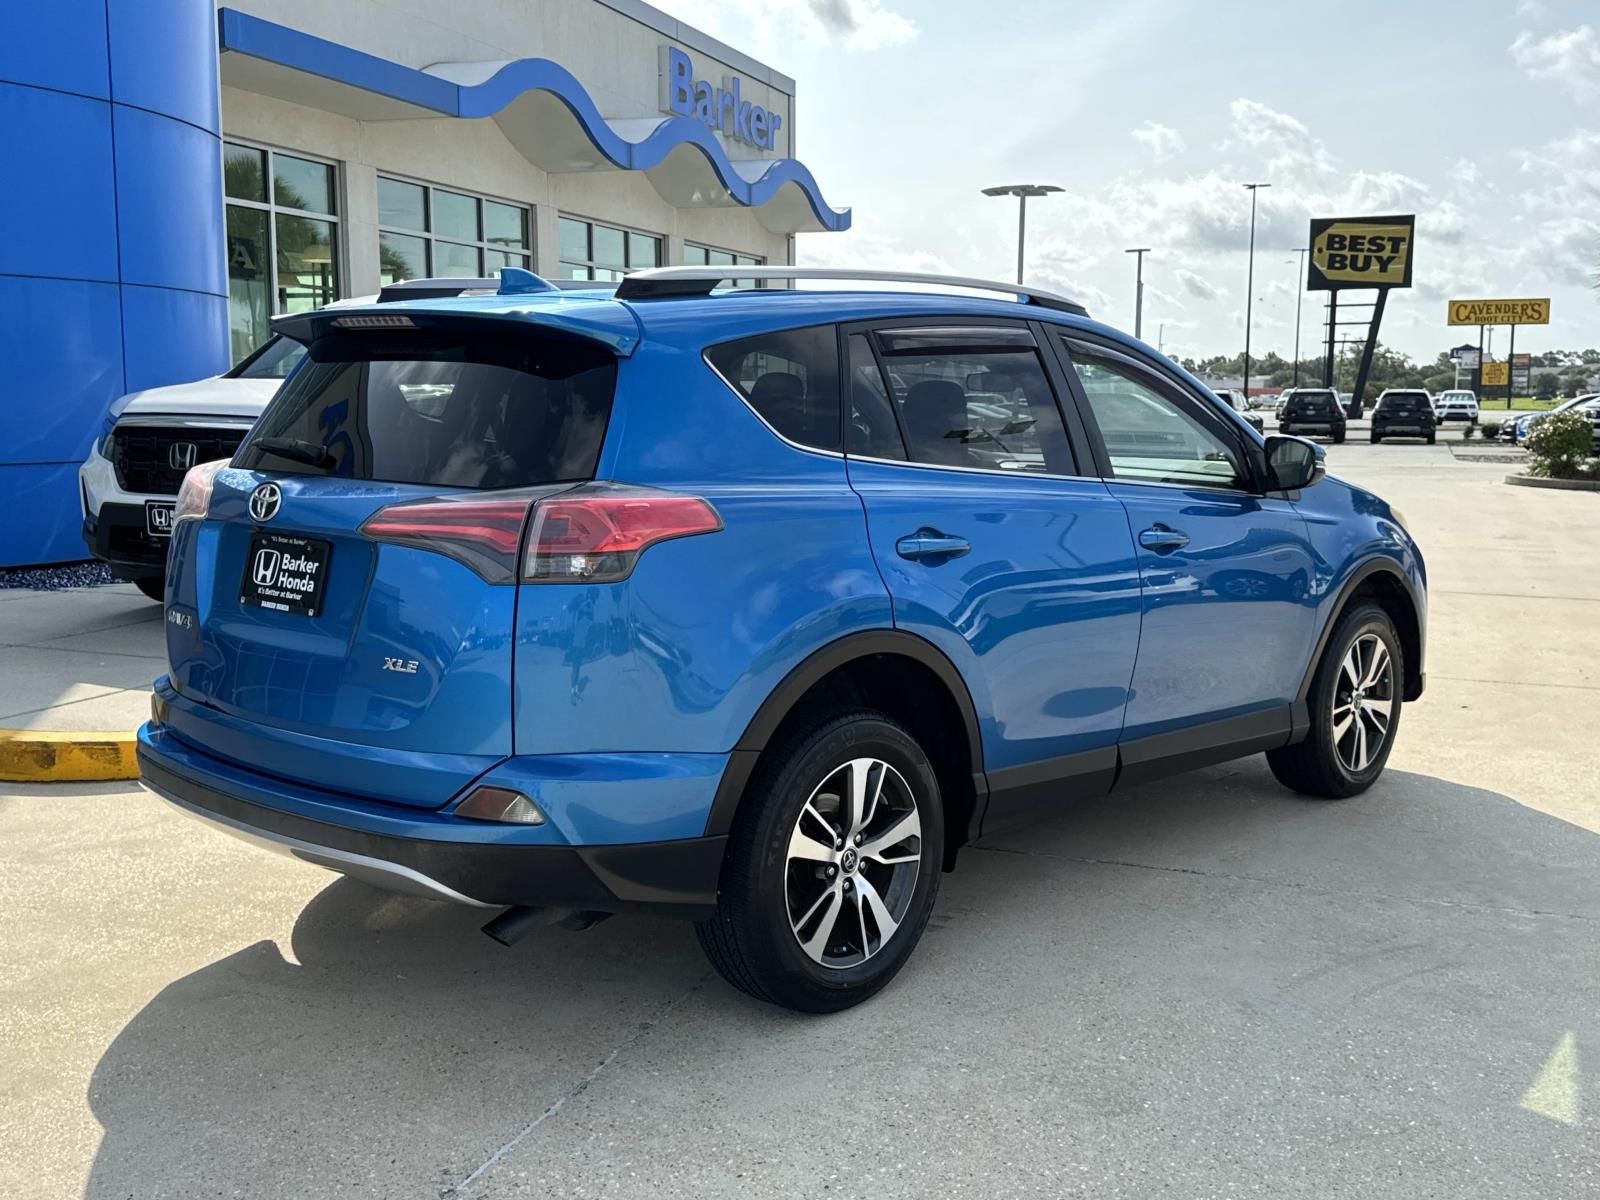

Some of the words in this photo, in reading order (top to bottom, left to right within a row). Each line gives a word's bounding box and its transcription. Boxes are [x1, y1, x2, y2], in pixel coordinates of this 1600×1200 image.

[668, 46, 782, 151] Barker
[1326, 233, 1406, 254] BEST
[1327, 253, 1398, 273] BUY
[1455, 302, 1542, 321] CAVENDER'S
[281, 553, 319, 573] Barker
[278, 572, 314, 592] Honda
[382, 657, 419, 674] XLE
